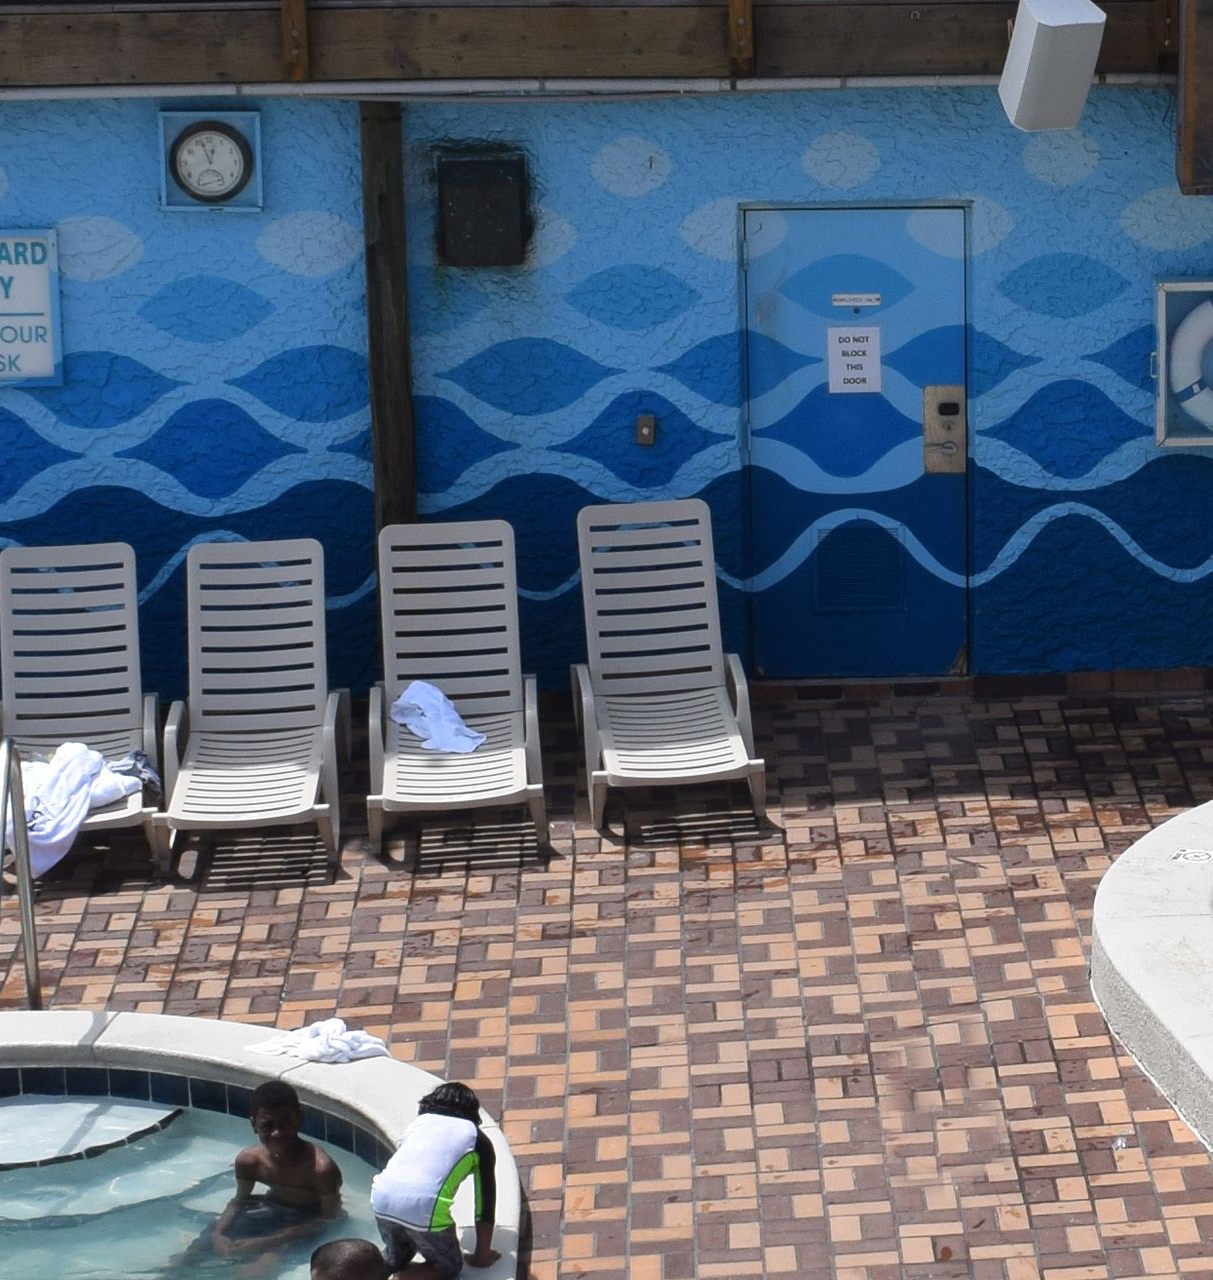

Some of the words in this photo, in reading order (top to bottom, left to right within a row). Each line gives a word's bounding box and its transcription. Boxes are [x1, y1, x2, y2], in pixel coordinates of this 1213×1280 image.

[838, 336, 851, 344] DO
[852, 336, 869, 344] NOT
[845, 363, 863, 371] THIS
[843, 377, 867, 385] DOOR
